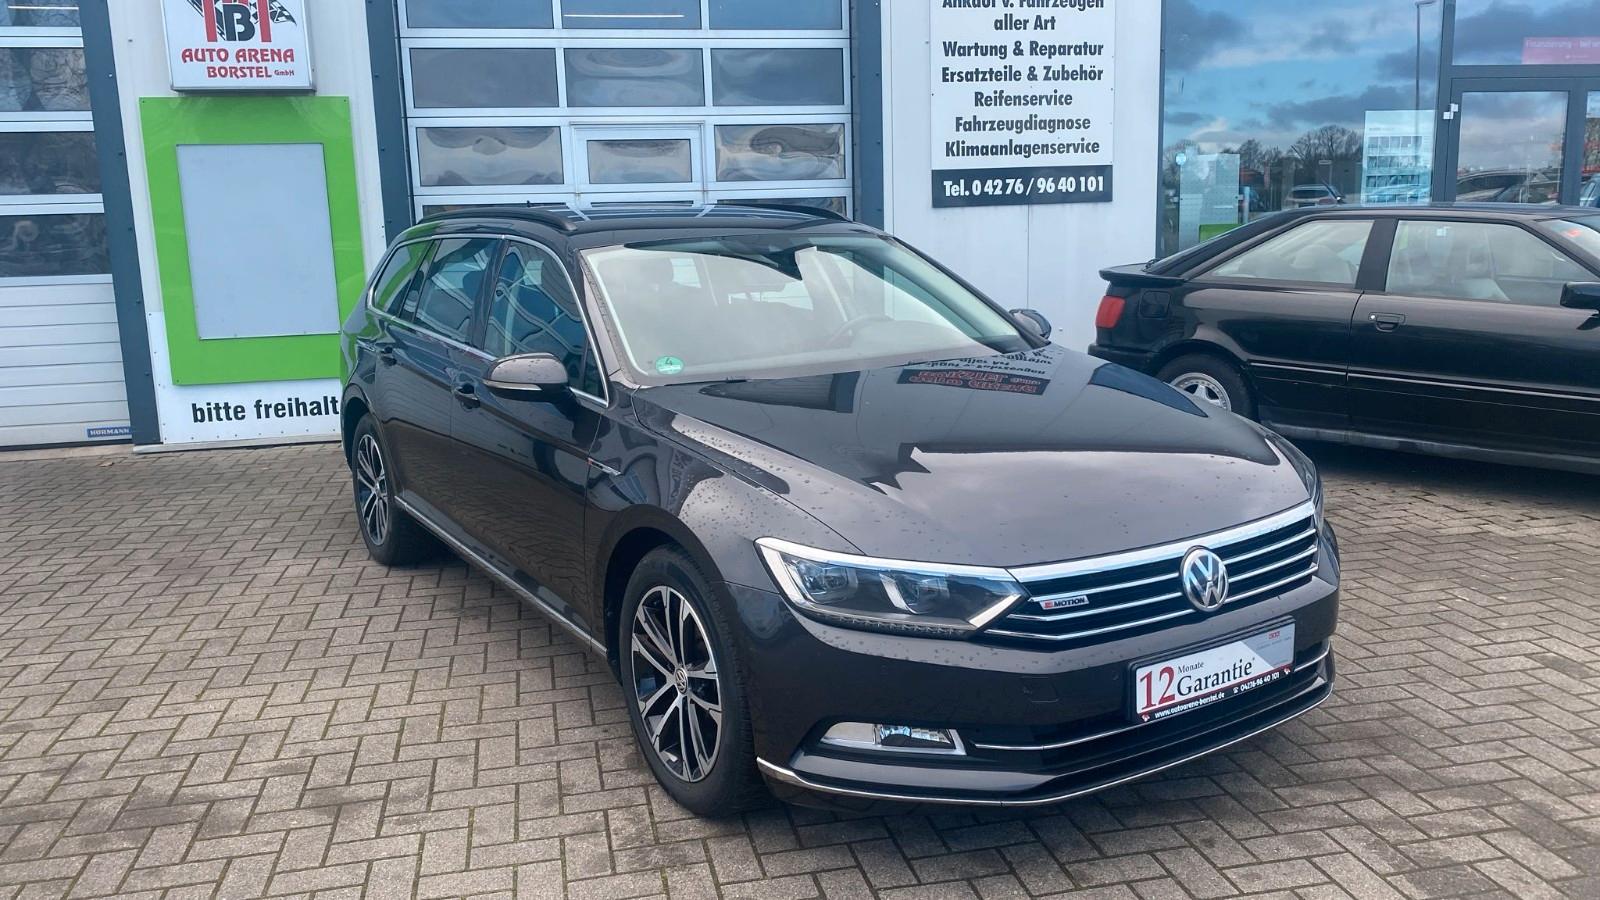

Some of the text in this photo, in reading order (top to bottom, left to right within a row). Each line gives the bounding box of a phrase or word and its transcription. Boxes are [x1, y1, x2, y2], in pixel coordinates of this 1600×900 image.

[1002, 0, 1014, 8] v.
[994, 13, 1056, 31] aller Art
[181, 48, 295, 63] AUTO ARENA
[943, 40, 1104, 60] Wartung & Reparatur
[206, 66, 295, 79] BORSTEL GmbH
[942, 64, 1104, 83] Ersatzteile & Zubehör
[974, 89, 1073, 107] Reifenservice
[955, 114, 1091, 134] Fahrzeugdiagnose
[945, 137, 1100, 158] Klimaanlagenservice
[943, 179, 969, 197] Tel.
[972, 180, 982, 196] 0
[983, 179, 1003, 195] 42
[1005, 178, 1024, 194] 76
[1036, 177, 1055, 193] 96
[1057, 176, 1076, 192] 40
[1079, 175, 1104, 192] 101
[192, 402, 246, 423] bitte
[1177, 661, 1205, 675] Monate
[1139, 665, 1176, 711] 12
